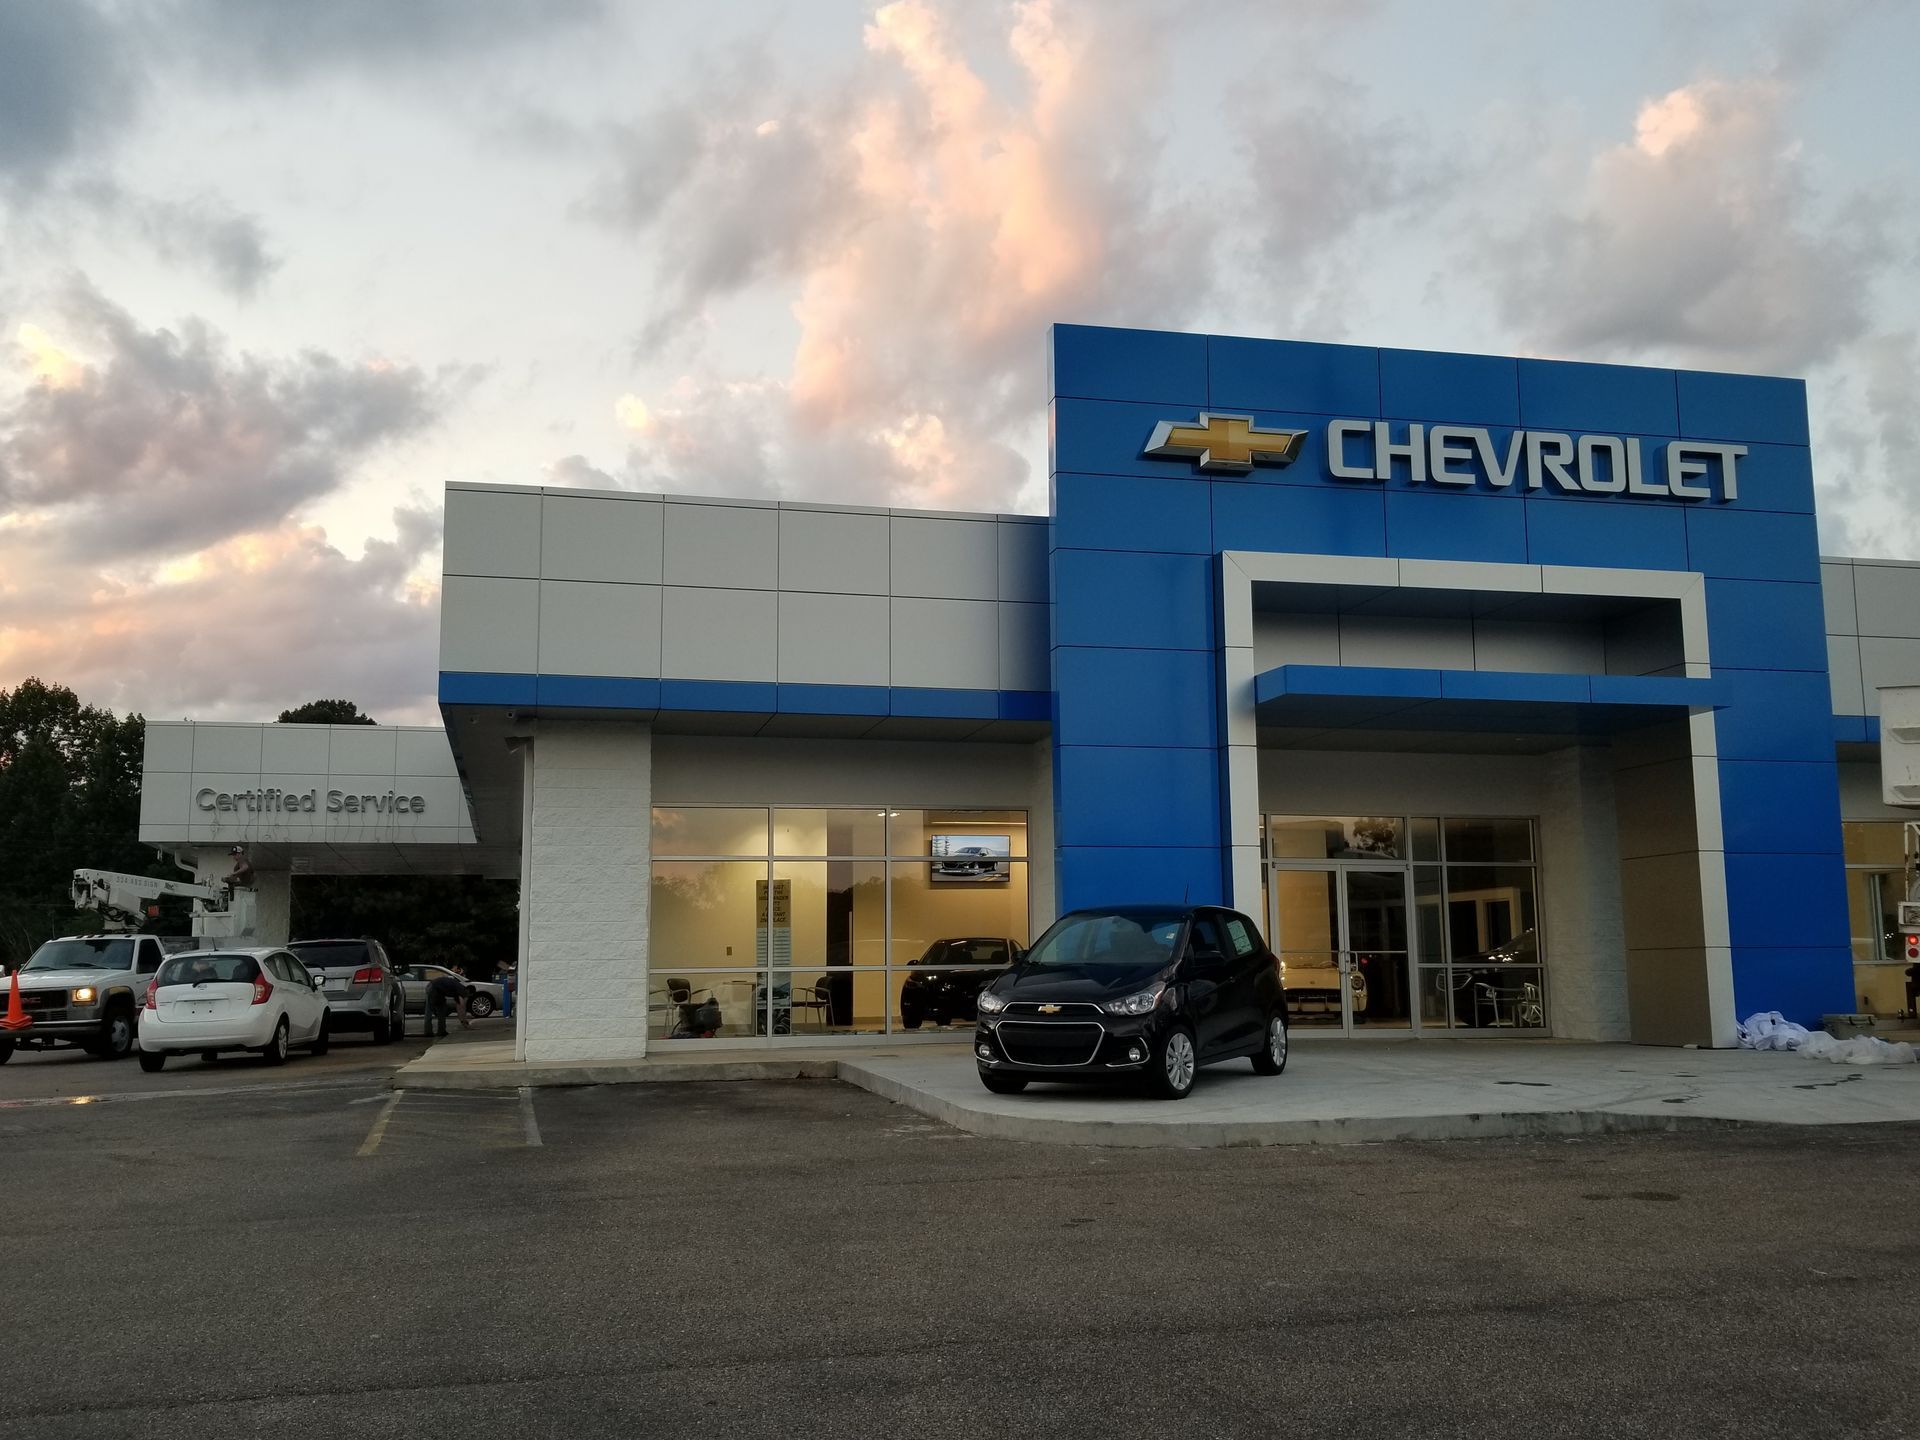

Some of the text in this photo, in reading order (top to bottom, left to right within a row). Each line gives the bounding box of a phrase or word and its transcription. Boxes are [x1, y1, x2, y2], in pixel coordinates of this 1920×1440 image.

[1328, 419, 1748, 500] CHEVROLET
[196, 787, 425, 814] Certified Service
